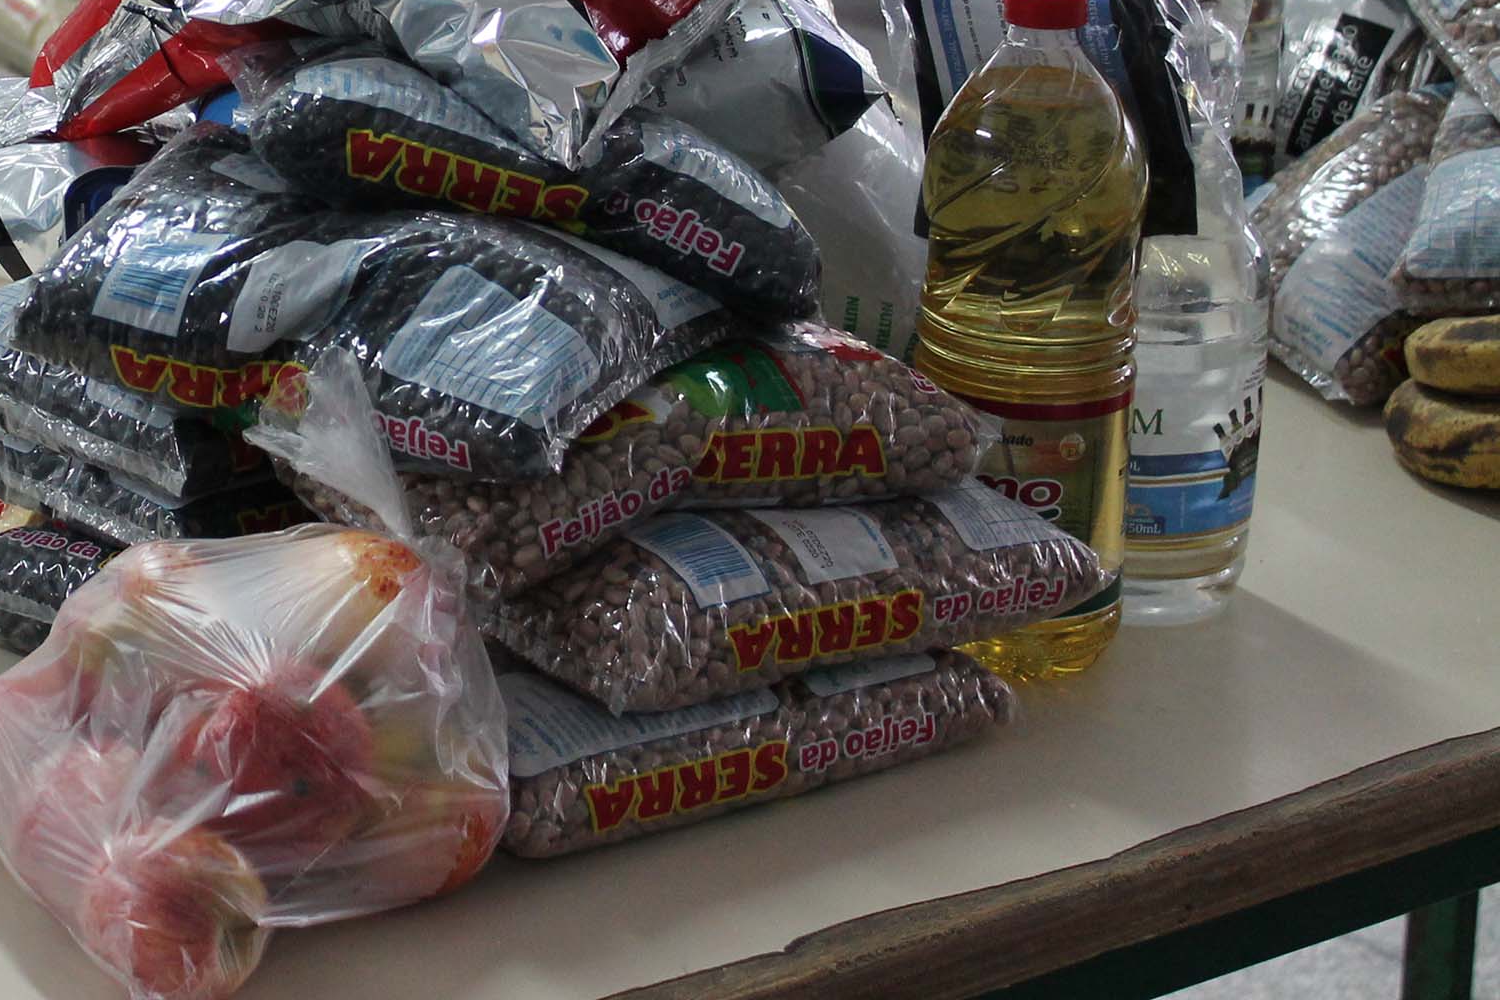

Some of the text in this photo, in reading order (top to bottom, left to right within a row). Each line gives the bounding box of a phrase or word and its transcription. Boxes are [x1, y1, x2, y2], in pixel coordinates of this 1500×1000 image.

[346, 128, 590, 227] SERRA
[633, 197, 746, 278] Feijão
[539, 424, 887, 559] Feijão da SERRA
[67, 541, 102, 561] da
[727, 578, 1064, 671] Feijão da SERRA
[586, 711, 938, 833] Feijão da SERRA
